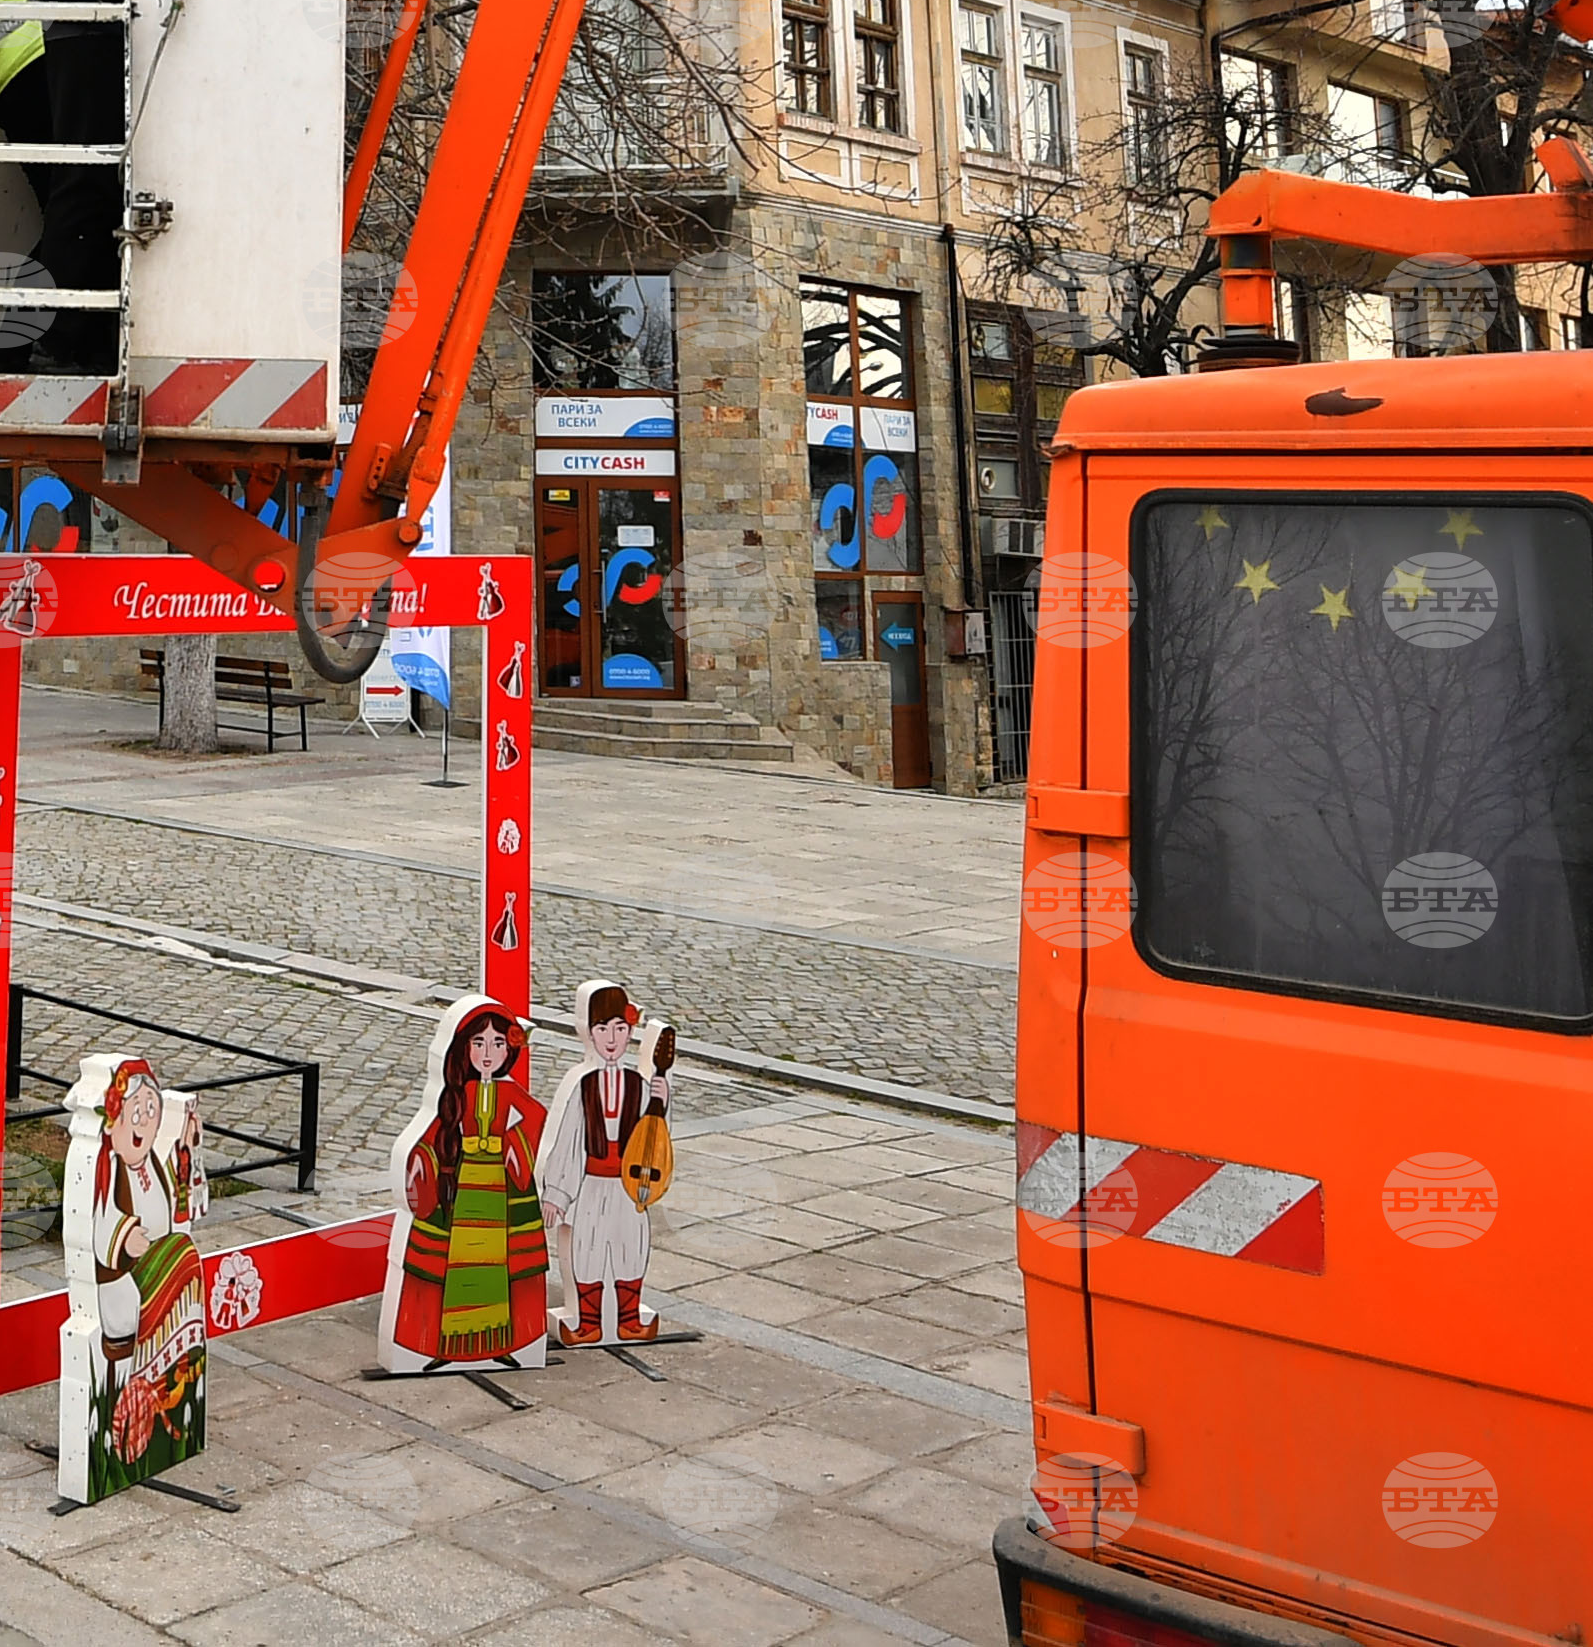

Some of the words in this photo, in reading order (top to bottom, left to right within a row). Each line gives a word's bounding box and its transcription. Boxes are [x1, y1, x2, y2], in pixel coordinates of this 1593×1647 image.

[551, 404, 585, 415] ПАРИ
[588, 404, 603, 415] ЗА
[807, 406, 839, 420] YCASH
[558, 417, 597, 428] ВСЕКИ
[563, 456, 645, 470] CITYCASH
[113, 582, 248, 619] Честита
